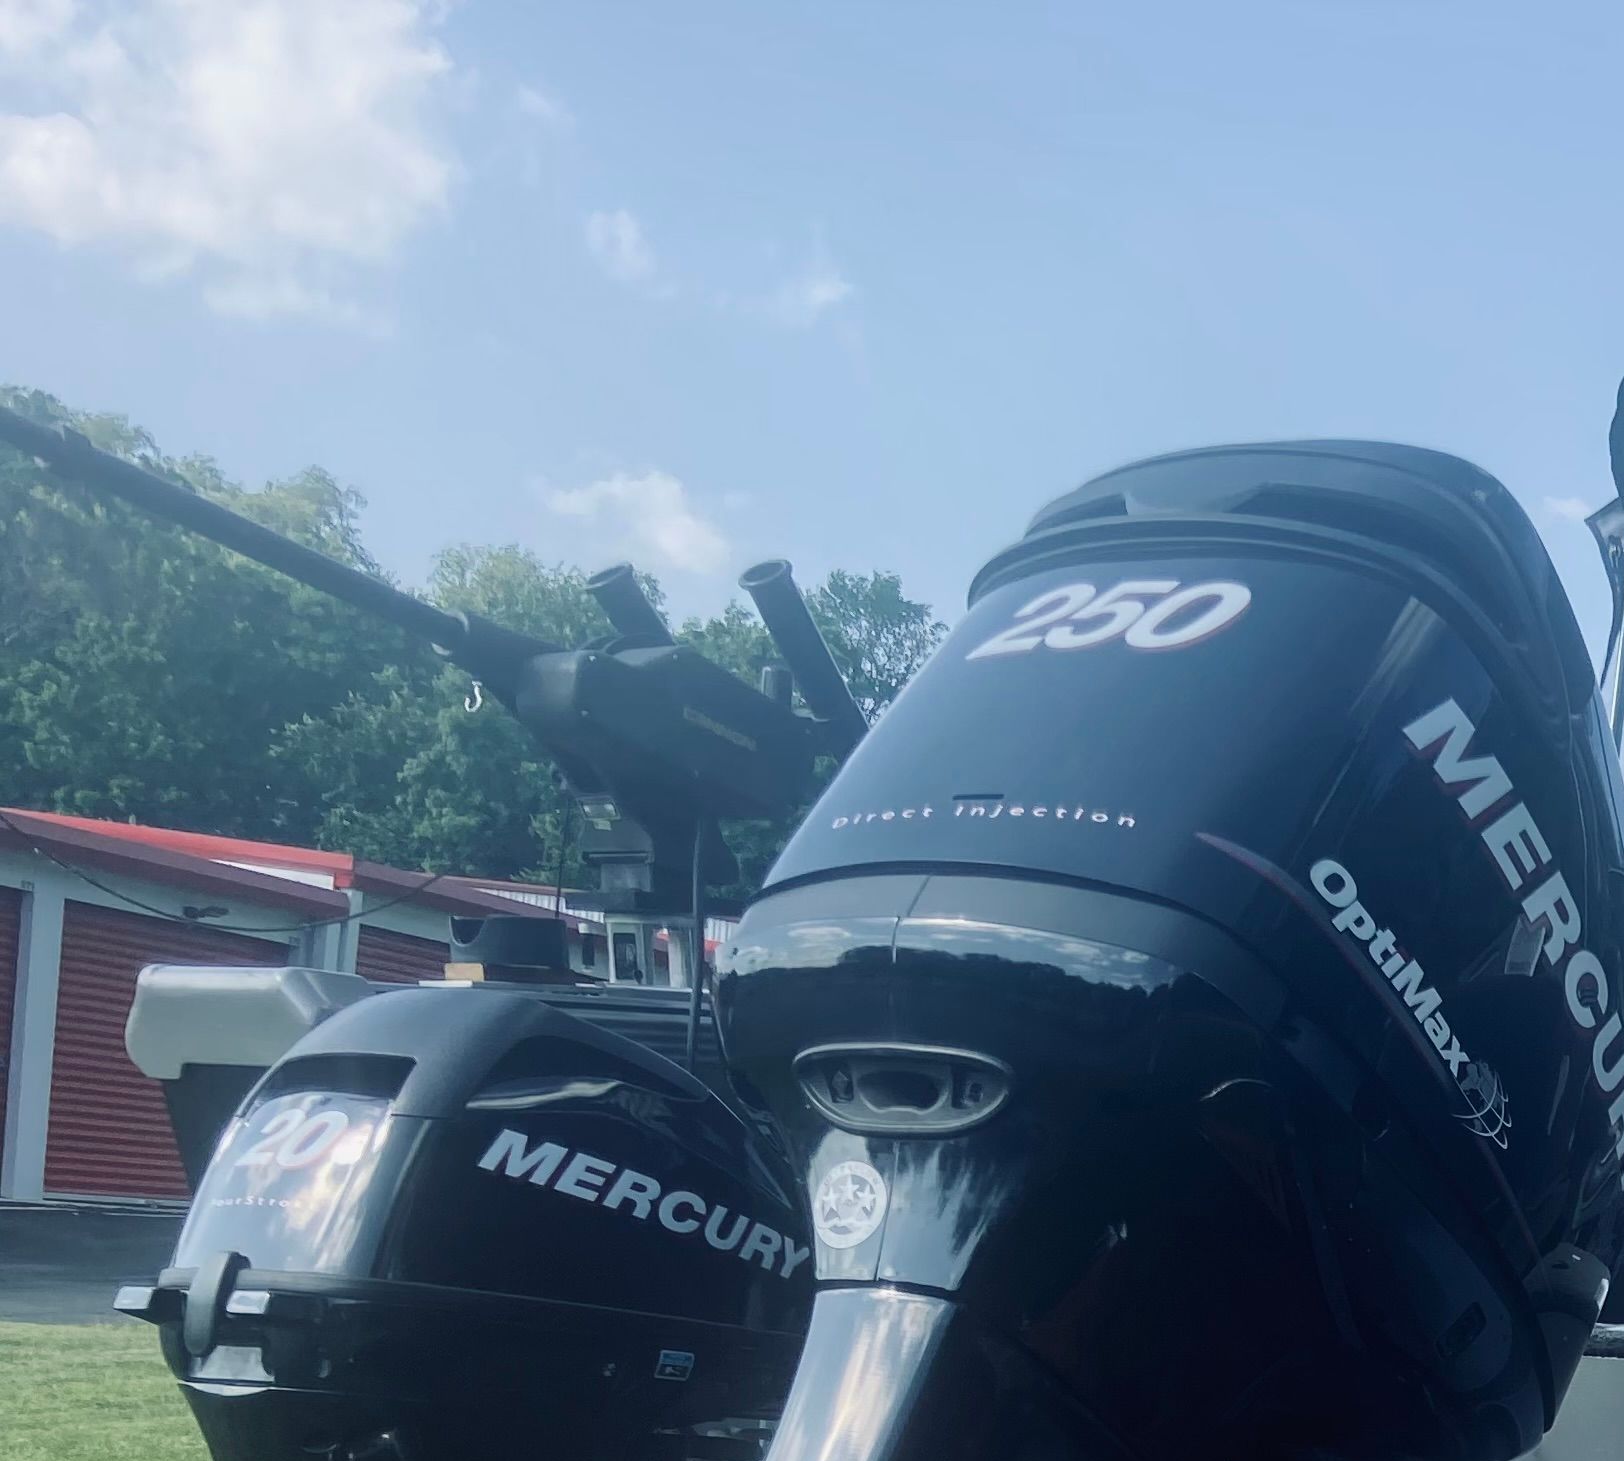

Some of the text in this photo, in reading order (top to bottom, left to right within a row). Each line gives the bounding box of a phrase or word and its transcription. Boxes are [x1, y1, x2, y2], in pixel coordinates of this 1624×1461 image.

[966, 580, 1252, 660] 250
[832, 804, 934, 830] Direct
[1309, 859, 1470, 1078] OptiMax
[234, 1108, 349, 1170] 20
[477, 1129, 812, 1281] MERCURY
